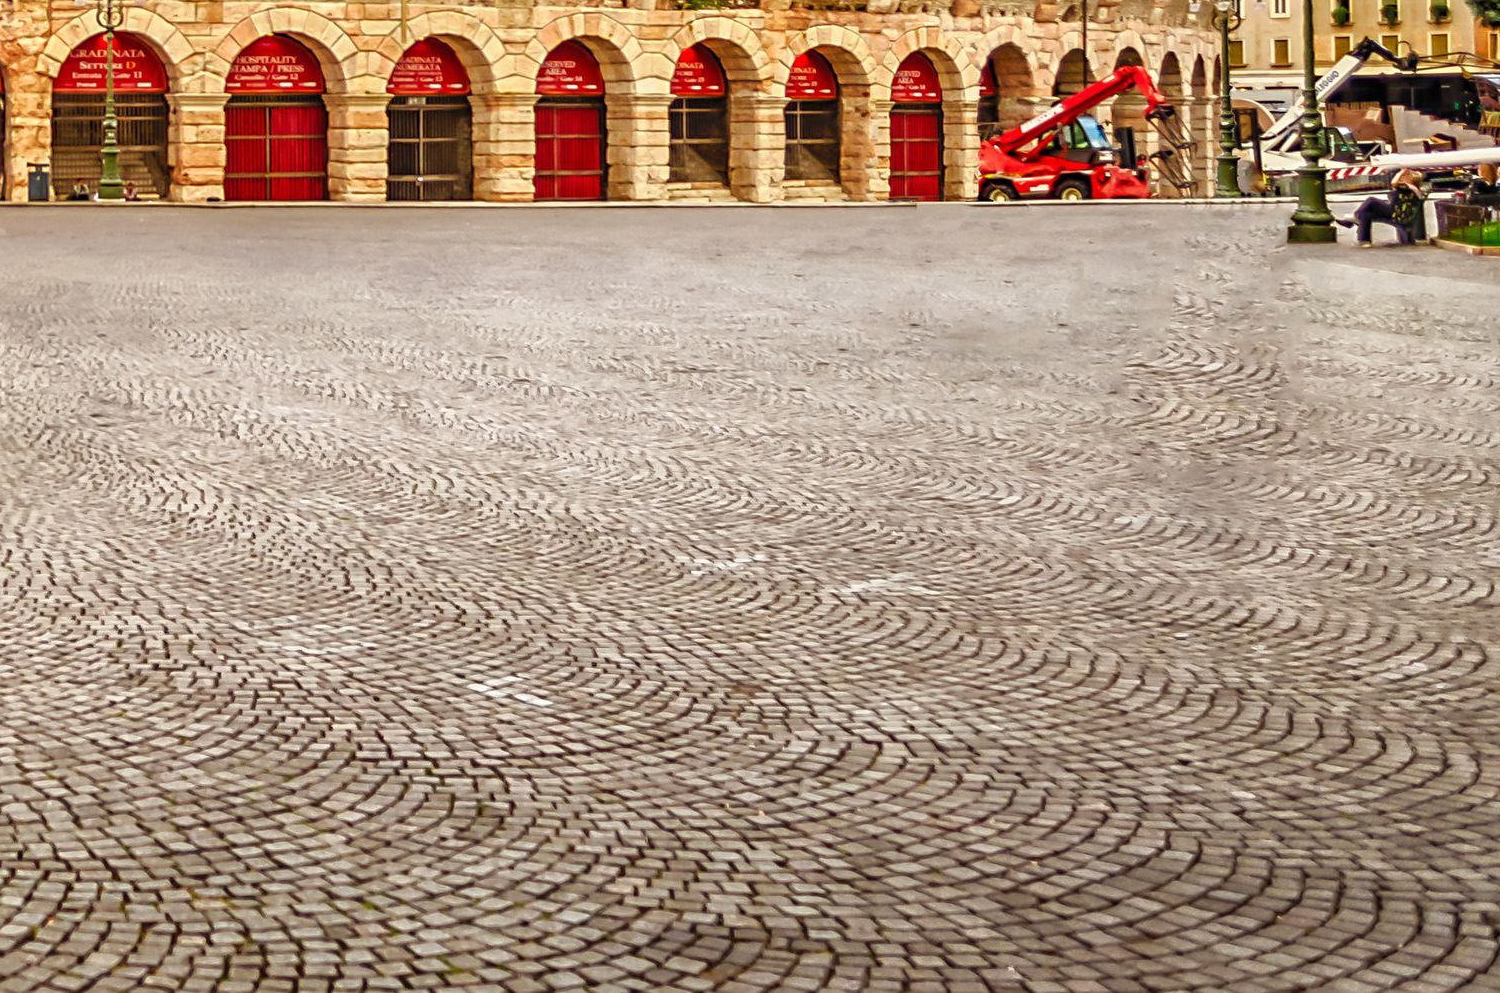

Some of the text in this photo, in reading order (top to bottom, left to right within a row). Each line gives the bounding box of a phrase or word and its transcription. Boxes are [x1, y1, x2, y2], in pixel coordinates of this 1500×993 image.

[71, 49, 146, 58] GRADNATA
[235, 55, 297, 64] HOSPITALITY
[276, 64, 305, 73] PRESS
